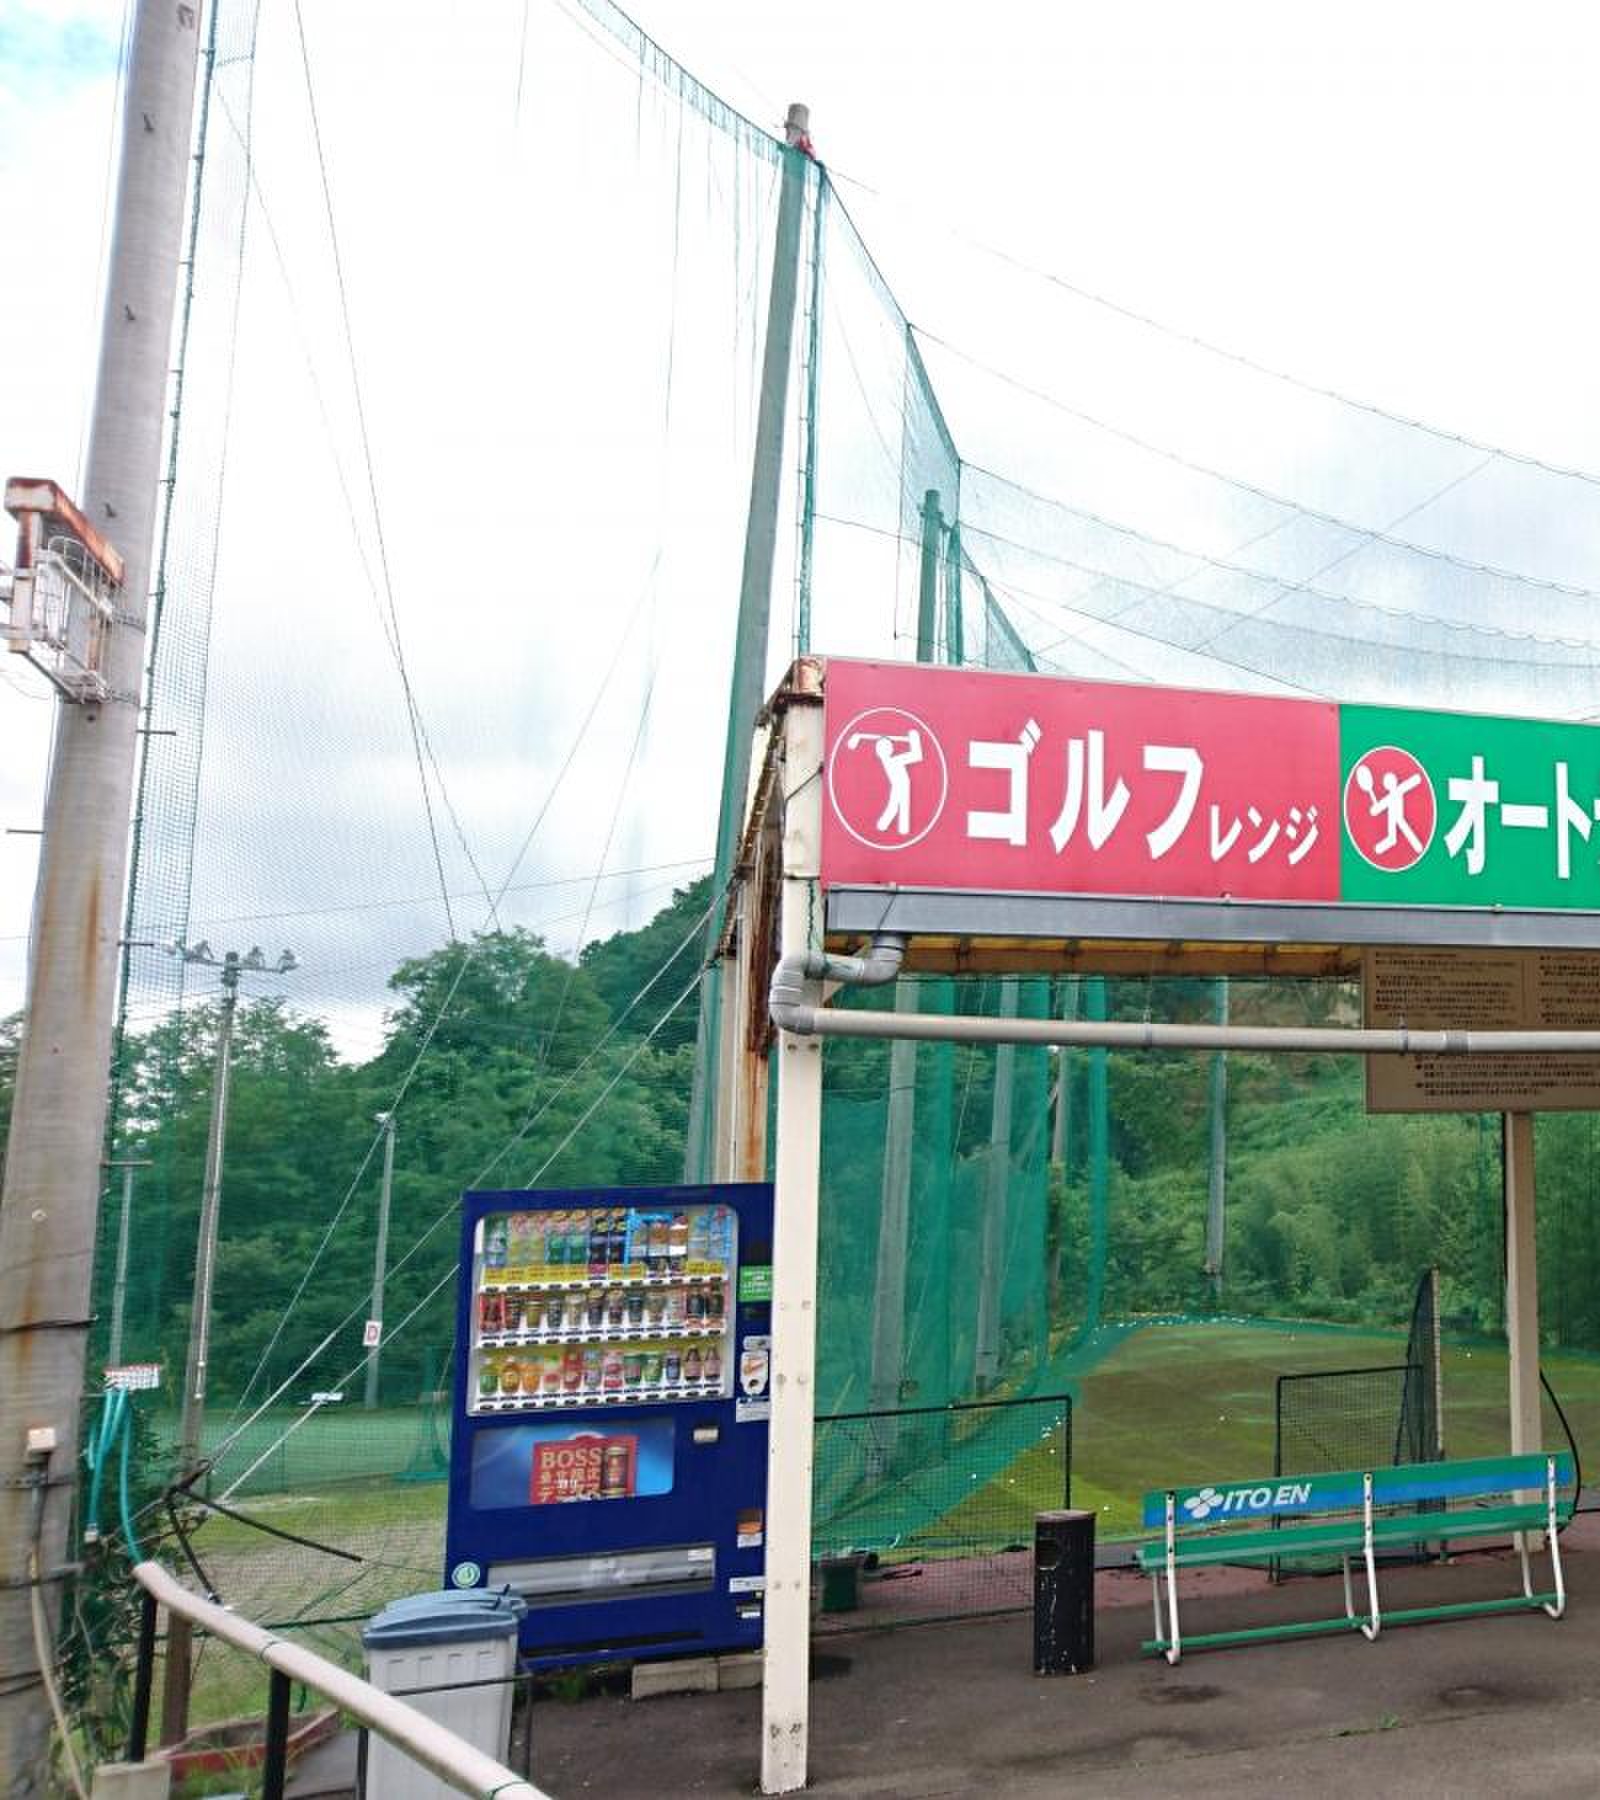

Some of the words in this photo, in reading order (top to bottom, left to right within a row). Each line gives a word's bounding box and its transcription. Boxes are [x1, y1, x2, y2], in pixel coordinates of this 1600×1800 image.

[541, 1447, 602, 1469] BOSS
[1223, 1488, 1271, 1511] ITO
[1274, 1484, 1311, 1504] EN
